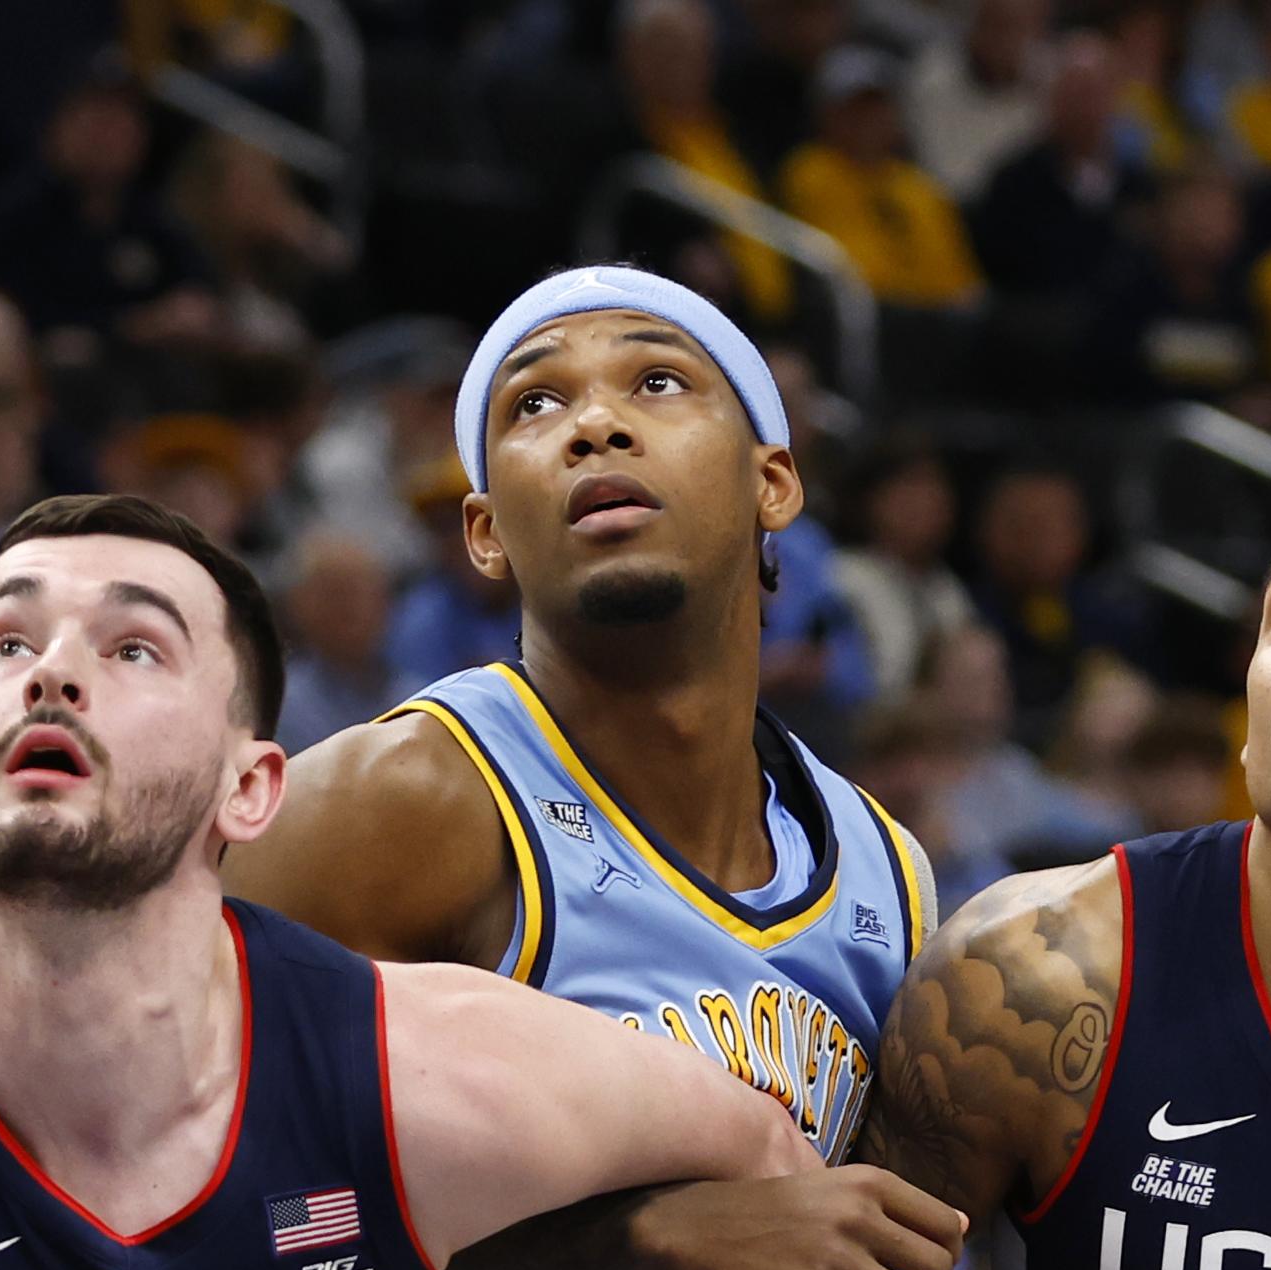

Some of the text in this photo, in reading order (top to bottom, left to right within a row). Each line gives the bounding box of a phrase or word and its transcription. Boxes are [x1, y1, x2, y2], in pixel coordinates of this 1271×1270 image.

[555, 803, 585, 824] THE
[856, 904, 878, 922] BIG
[856, 917, 887, 935] EAST
[1143, 1156, 1217, 1186] BE THE
[1131, 1173, 1215, 1206] CHANGE
